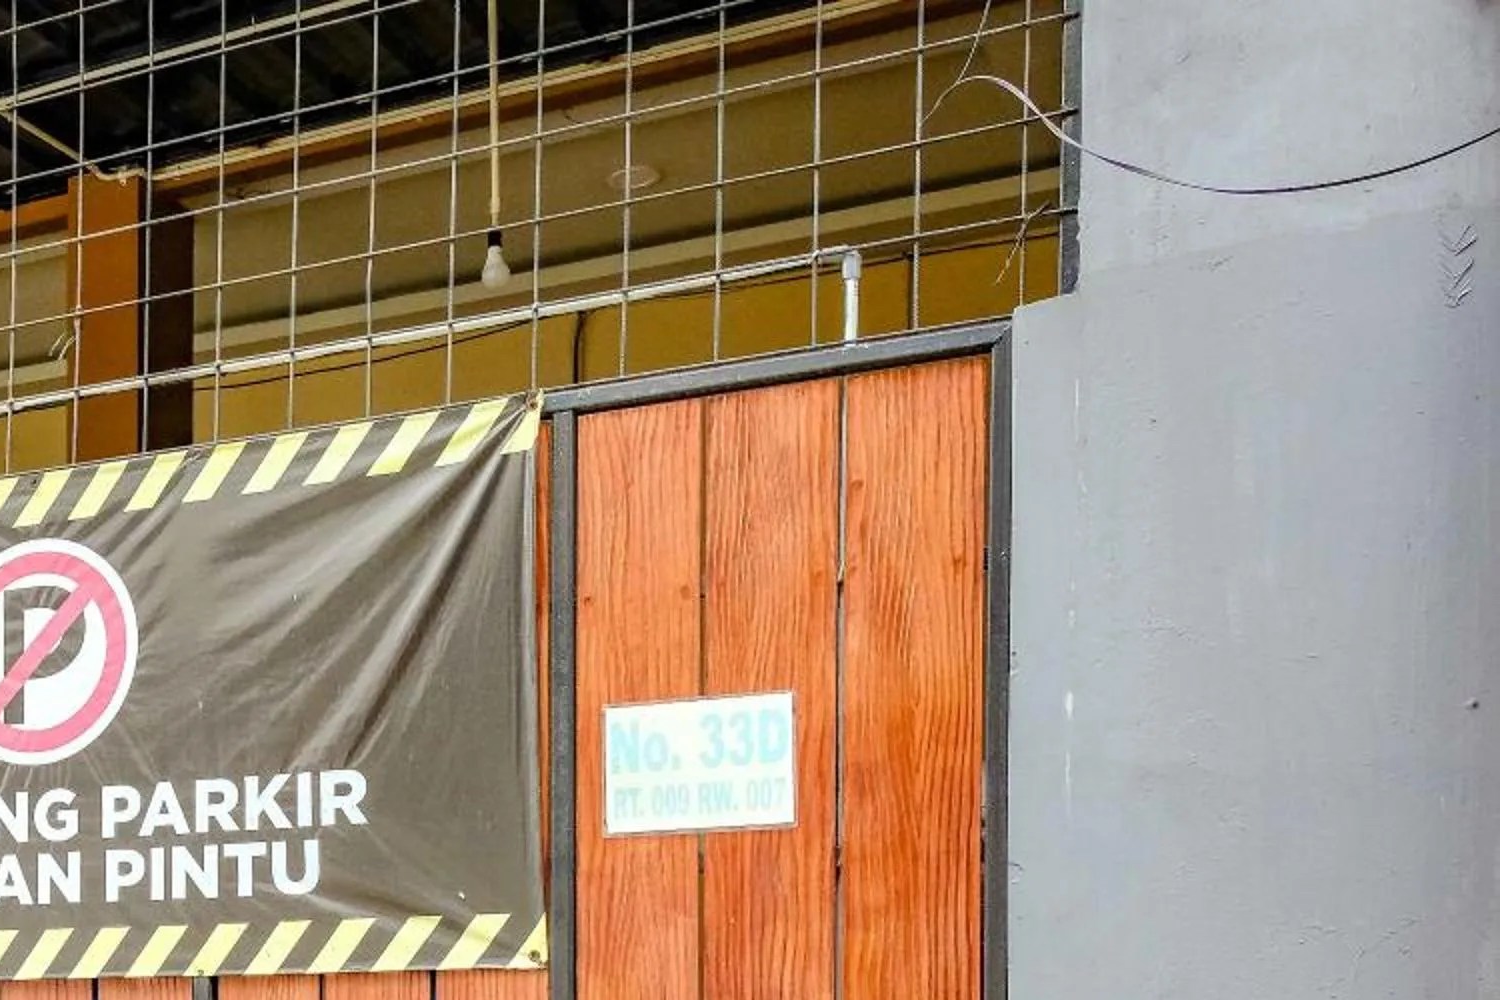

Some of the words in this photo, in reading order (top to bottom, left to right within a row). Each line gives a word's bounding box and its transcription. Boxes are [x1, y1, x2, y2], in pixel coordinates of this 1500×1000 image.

[610, 719, 682, 774] No.
[700, 708, 789, 769] 33D
[101, 769, 368, 839] PARKIR
[613, 787, 645, 820] RT.
[698, 780, 739, 815] RW.
[746, 777, 786, 812] 007
[105, 838, 320, 903] PINTU
